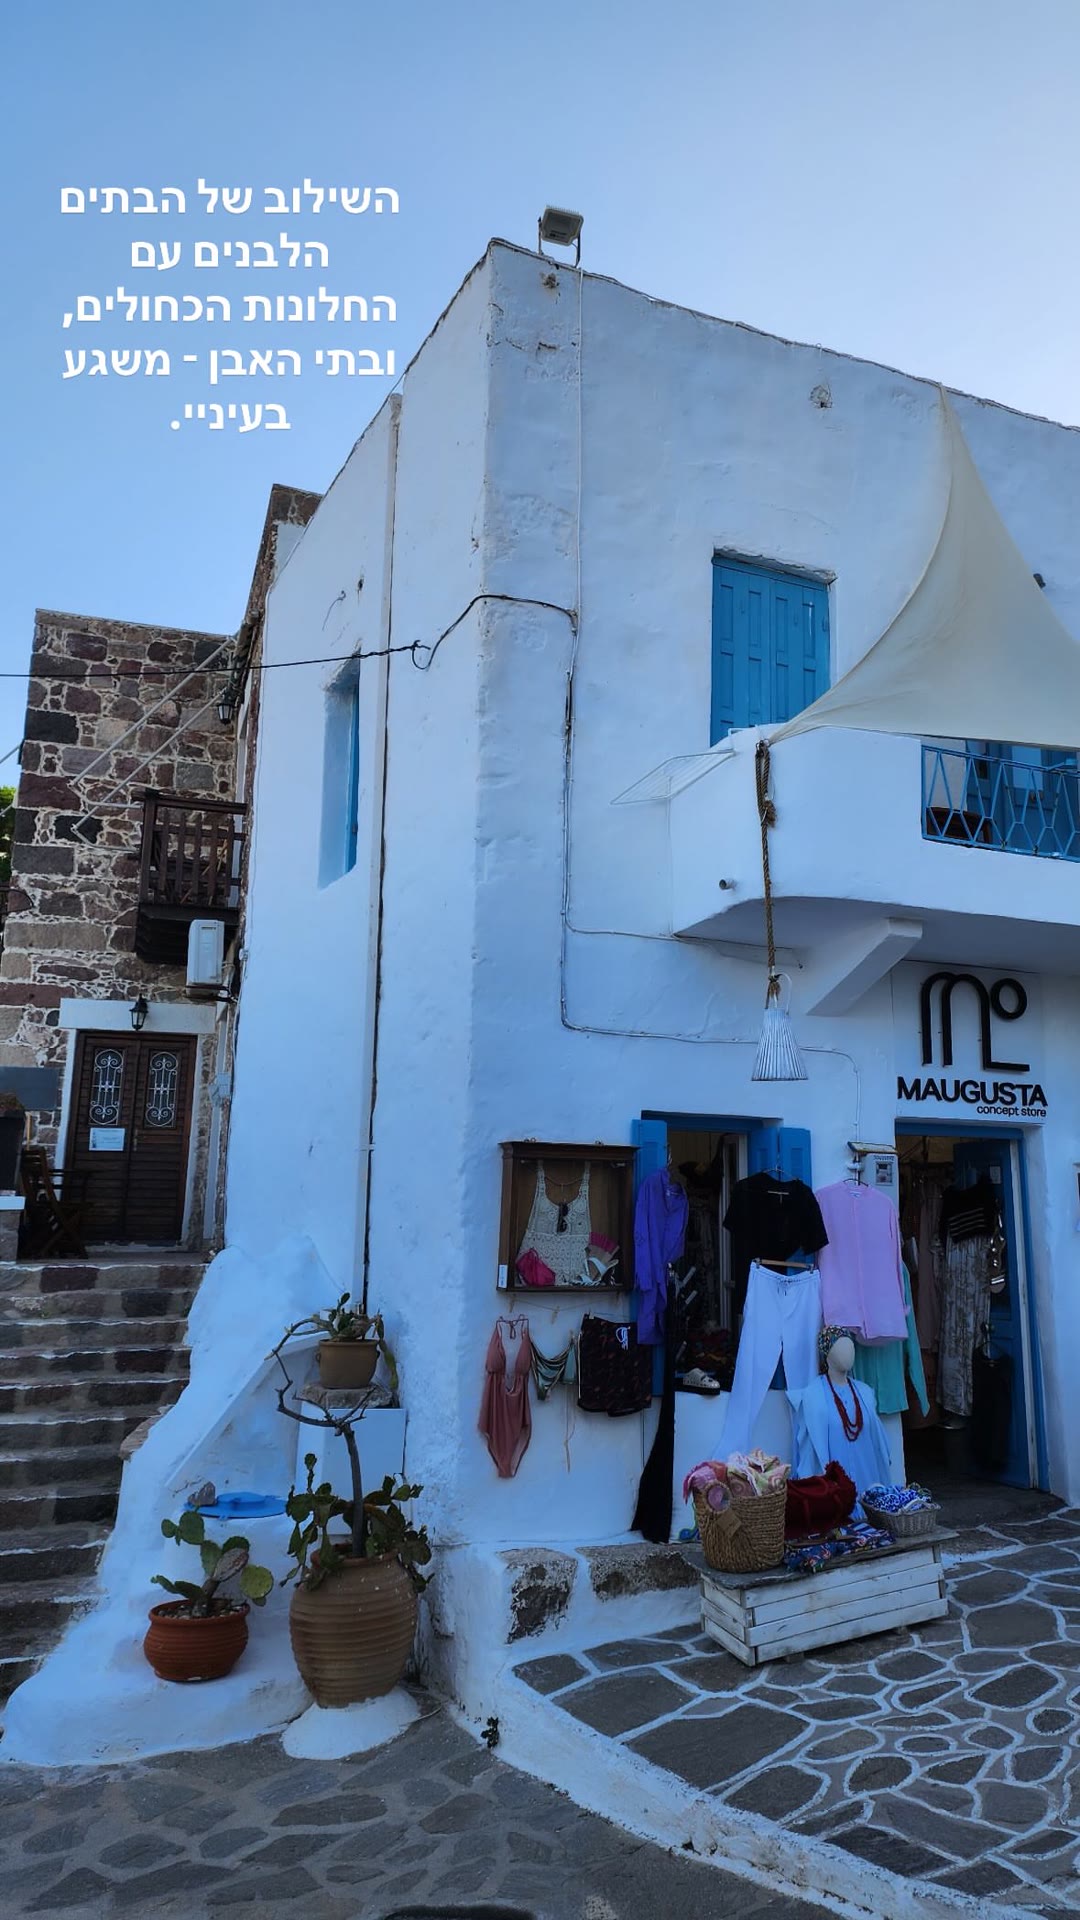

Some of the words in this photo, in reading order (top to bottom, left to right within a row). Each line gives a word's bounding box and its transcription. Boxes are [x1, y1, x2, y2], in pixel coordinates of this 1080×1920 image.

[897, 1076, 1048, 1107] MAUGUSTA
[976, 1105, 1020, 1117] concept
[1020, 1107, 1047, 1118] store
